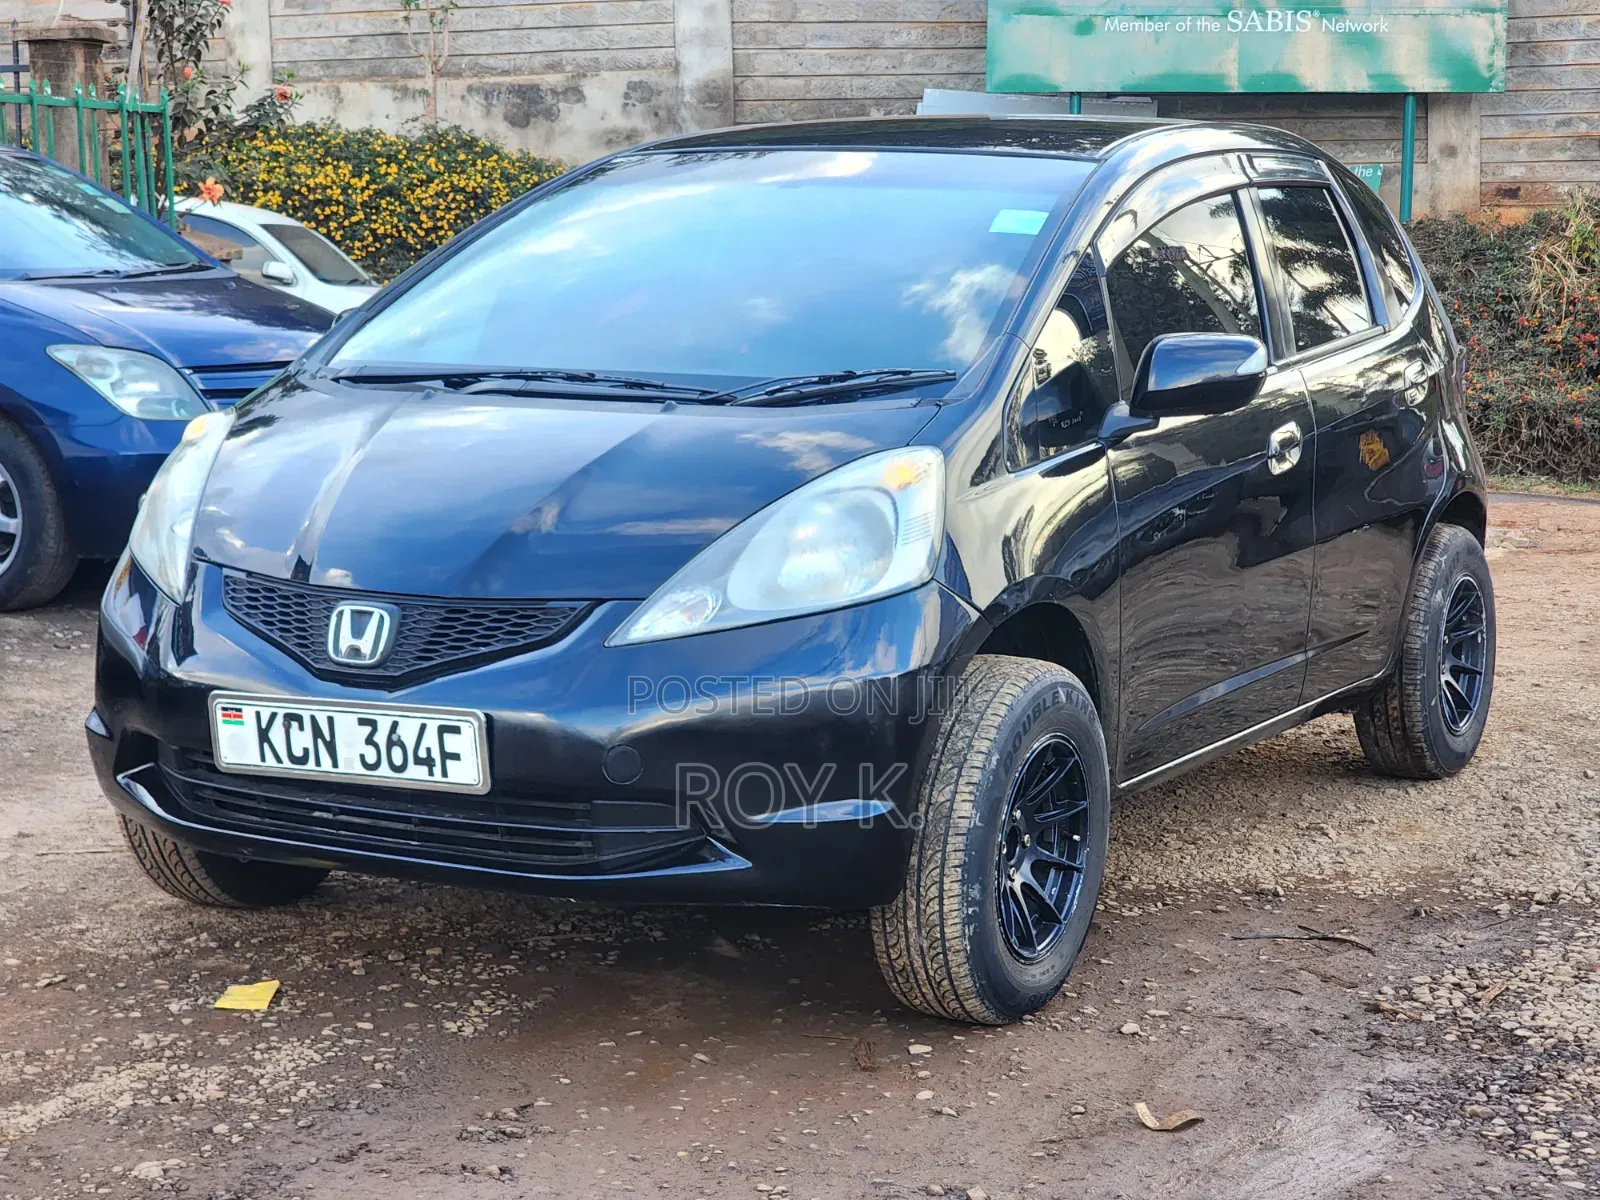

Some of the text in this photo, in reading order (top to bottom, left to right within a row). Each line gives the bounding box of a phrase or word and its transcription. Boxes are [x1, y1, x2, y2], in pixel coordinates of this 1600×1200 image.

[1104, 17, 1171, 32] Member
[1175, 17, 1192, 32] of
[1196, 17, 1221, 32] the
[1321, 17, 1389, 33] Network
[255, 710, 339, 768] KCN
[358, 717, 461, 778] 364F
